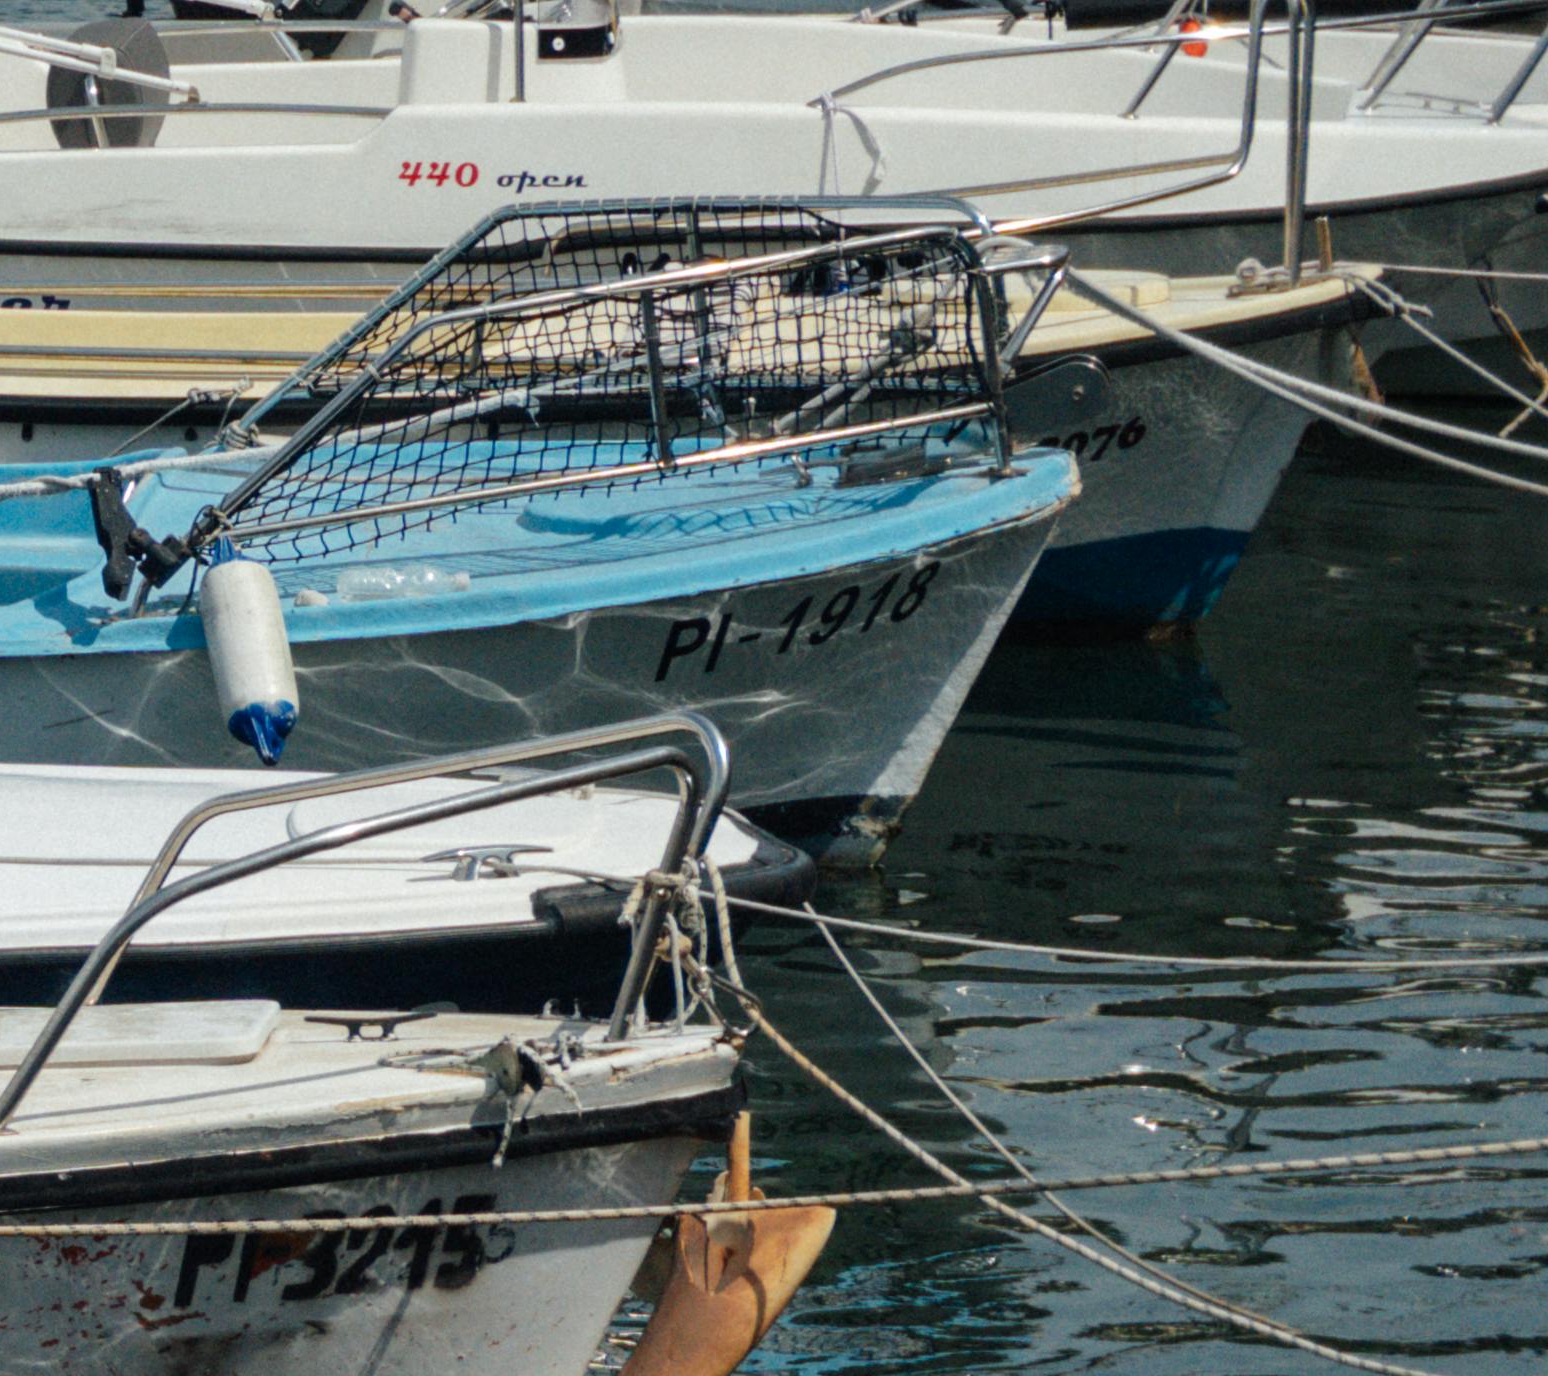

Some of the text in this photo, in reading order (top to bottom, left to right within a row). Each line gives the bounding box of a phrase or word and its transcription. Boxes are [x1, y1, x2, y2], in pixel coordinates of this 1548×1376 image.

[399, 161, 588, 194] 440 open
[655, 560, 941, 682] PI-1918
